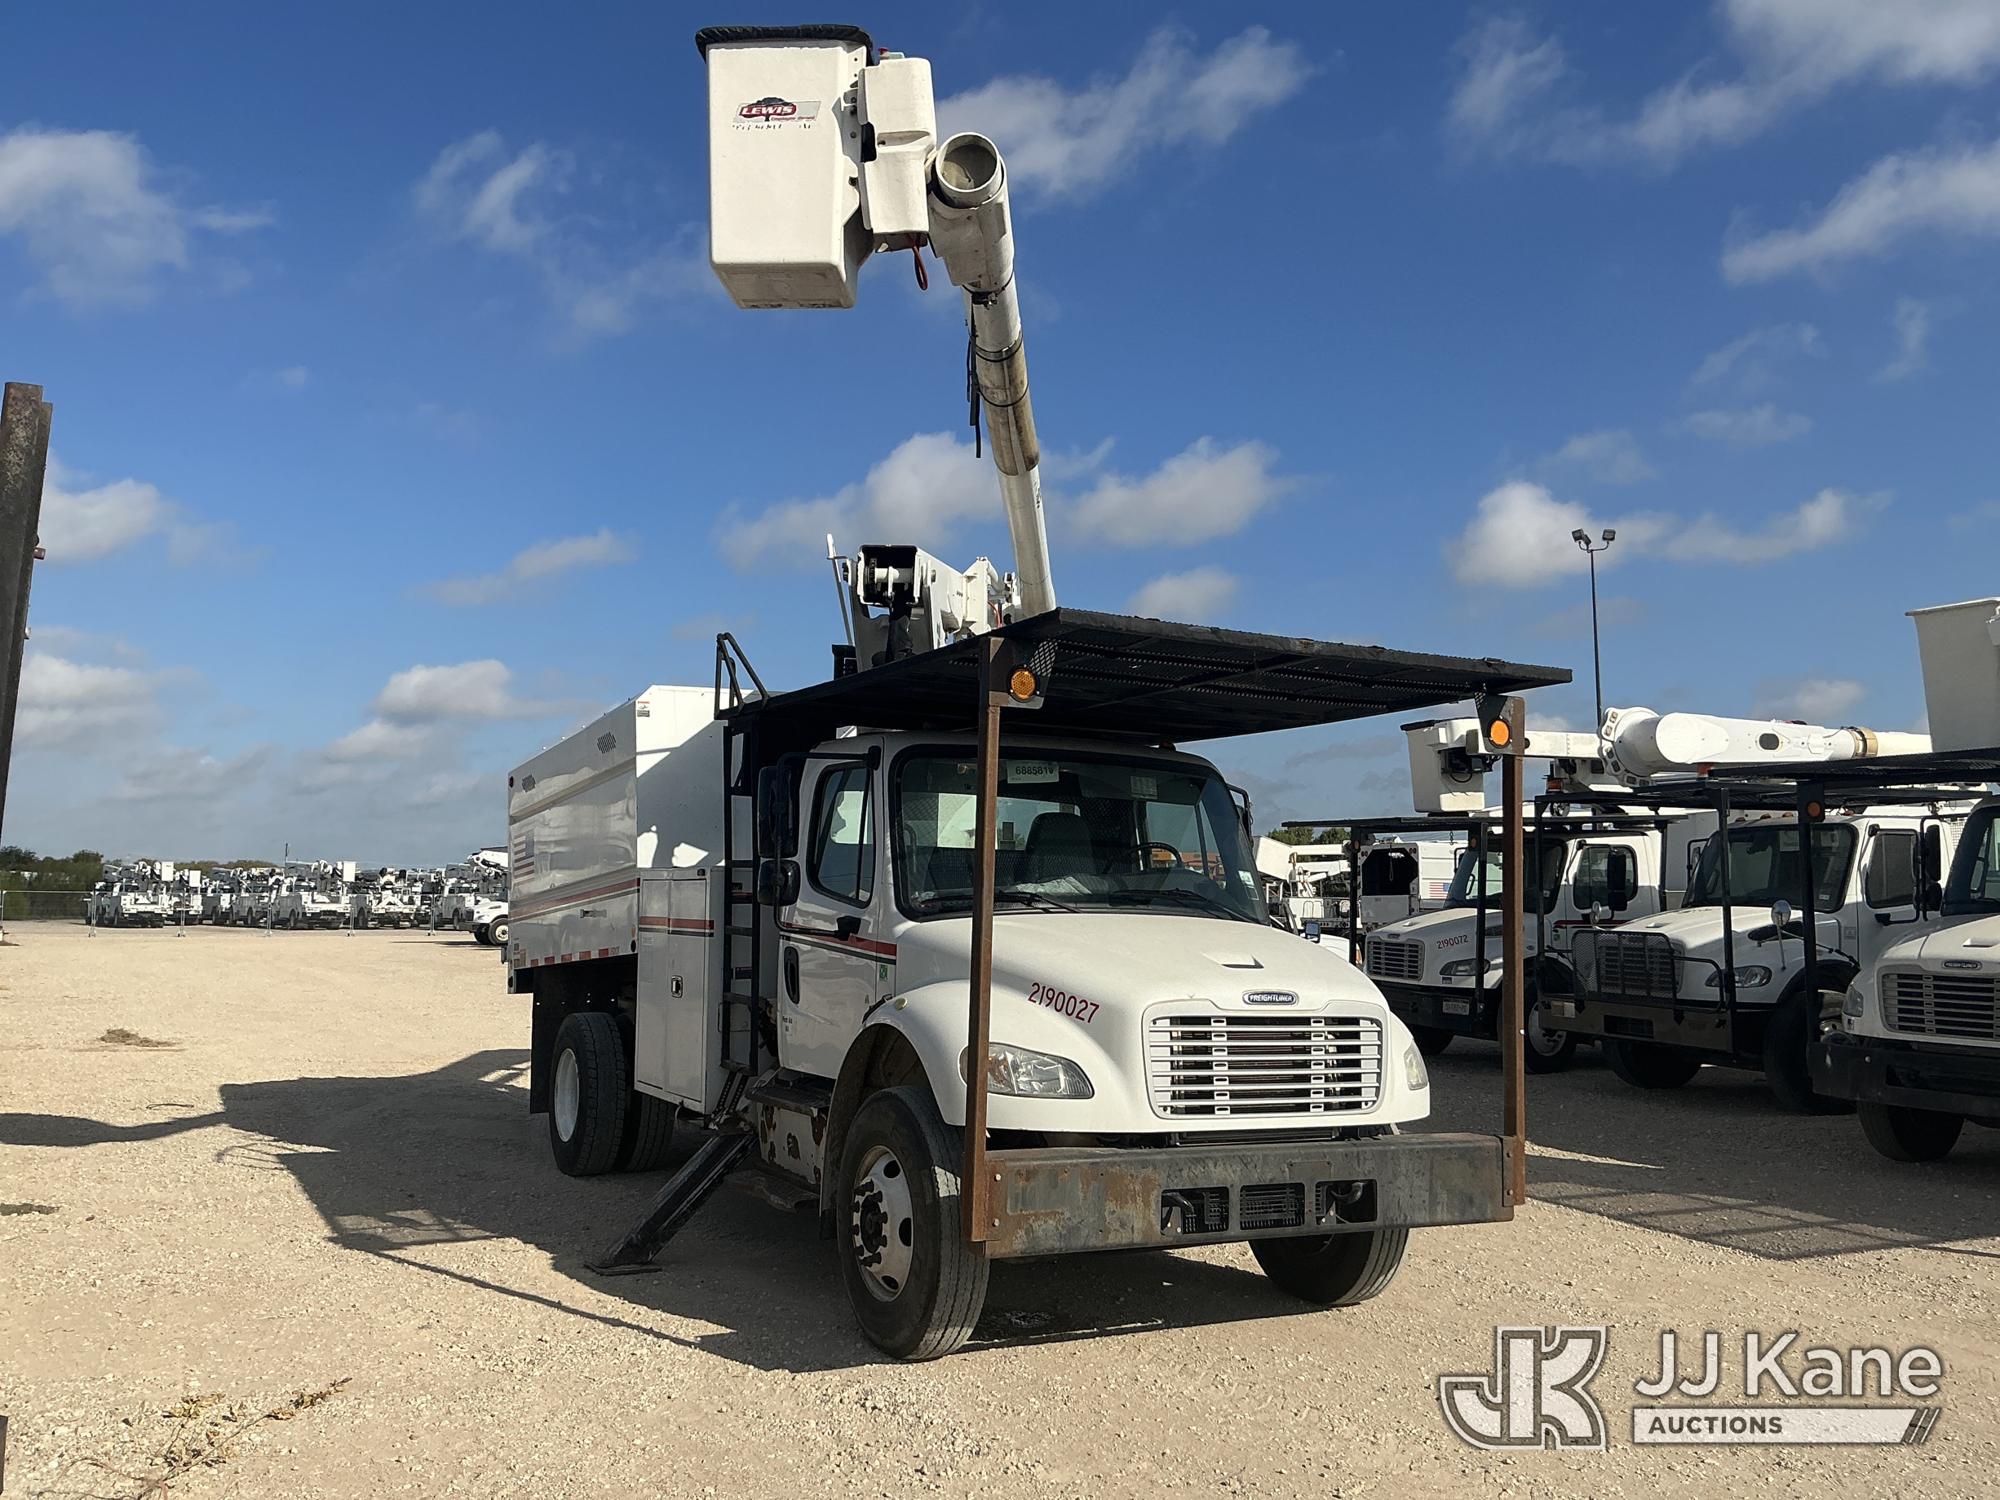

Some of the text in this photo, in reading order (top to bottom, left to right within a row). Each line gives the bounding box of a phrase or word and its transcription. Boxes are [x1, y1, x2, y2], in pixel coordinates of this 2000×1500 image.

[741, 105, 793, 115] LEWIS
[1436, 934, 1469, 949] 2190072
[1028, 982, 1100, 1023] 2190027
